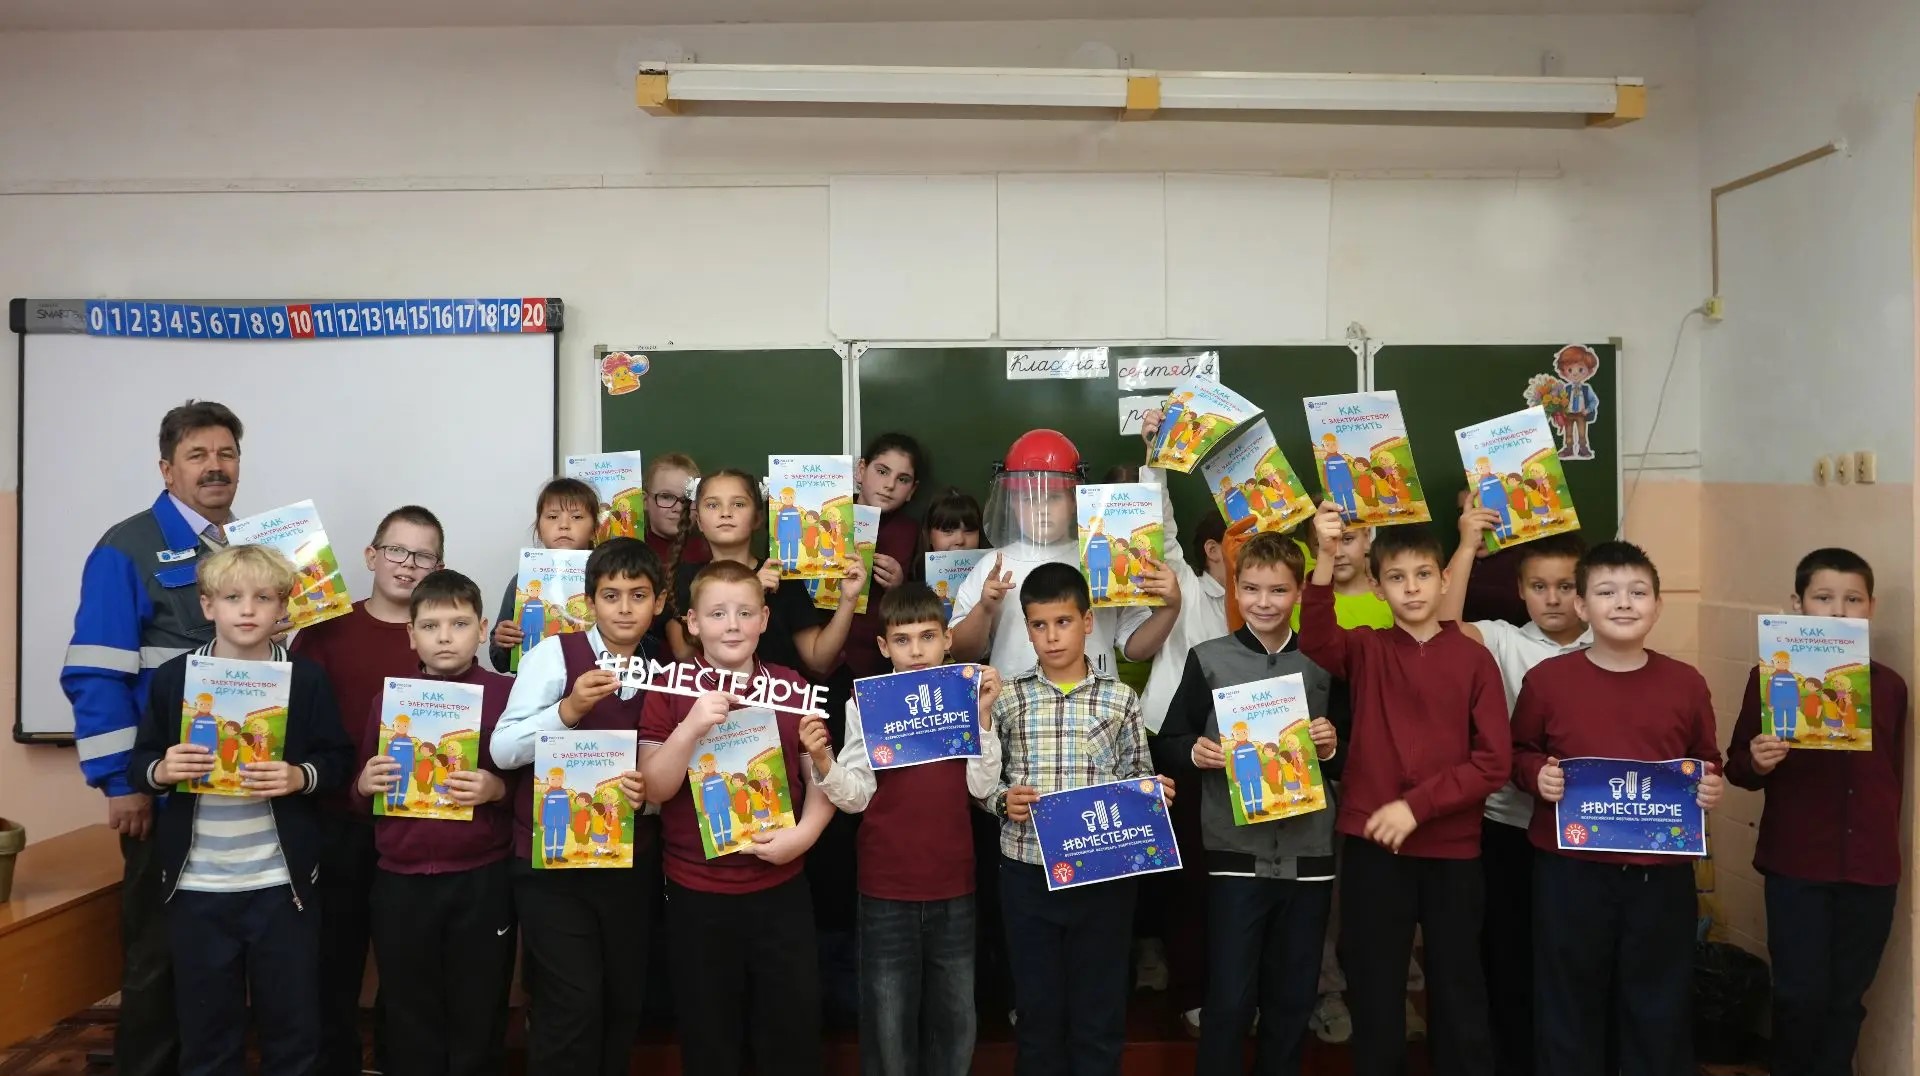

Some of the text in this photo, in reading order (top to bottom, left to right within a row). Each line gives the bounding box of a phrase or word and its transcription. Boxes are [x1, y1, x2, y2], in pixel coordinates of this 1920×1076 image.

[91, 307, 103, 330] 0
[111, 308, 121, 331] 1
[131, 309, 142, 332] 2
[150, 310, 162, 333] 3
[171, 311, 183, 333] 4
[190, 312, 202, 334] 5
[210, 313, 223, 335] 6
[228, 313, 240, 334] 7
[251, 313, 265, 334] 8
[271, 312, 285, 334] 9
[290, 310, 312, 334] 10
[314, 309, 334, 333] 11
[338, 309, 359, 332] 12
[361, 308, 382, 332] 13
[385, 305, 407, 331] 14
[409, 305, 429, 330] 15
[432, 305, 452, 329] 16
[455, 304, 475, 328] 17
[478, 304, 498, 327] 18
[501, 304, 521, 327] 19
[523, 303, 544, 327] 20
[1339, 405, 1361, 416] КАК
[1335, 422, 1383, 434] ДРУЖИТЬ
[1490, 425, 1512, 437] КАК
[1488, 438, 1532, 455] ДРУЖИТЬ
[802, 464, 822, 472] КАК
[796, 480, 837, 488] ДРУЖИТЬ
[1104, 508, 1145, 516] ДРУЖИТЬ
[261, 518, 283, 529] КАК
[1800, 627, 1825, 637] КАК
[1790, 644, 1845, 654] ДРУЖИТЬ
[225, 669, 250, 679] КАК
[595, 651, 830, 714] #ВМЕСТЕЯРЧЕ
[215, 687, 267, 697] ДРУЖИТЬ
[422, 692, 445, 701] КАК
[1251, 690, 1273, 702] КАК
[408, 701, 470, 711] ЭЛЕКТРИЧЕСТВОМ
[412, 708, 460, 720] ДРУЖИТЬ
[1247, 705, 1290, 720] ДРУЖИТЬ
[717, 721, 741, 733] КАК
[884, 711, 970, 734] #ВМЕСТЕЯРЧЕ
[575, 741, 598, 751] КАК
[714, 735, 760, 752] ДРУЖИТЬ
[561, 751, 624, 759] ЭЛЕКТРИЧЕСТВОМ
[566, 759, 615, 768] ДРУЖИТЬ
[1581, 801, 1682, 817] #ВМЕСТЕЯРЧЕ
[1062, 825, 1154, 851] #ВМЕСТЕЯРЧЕ
